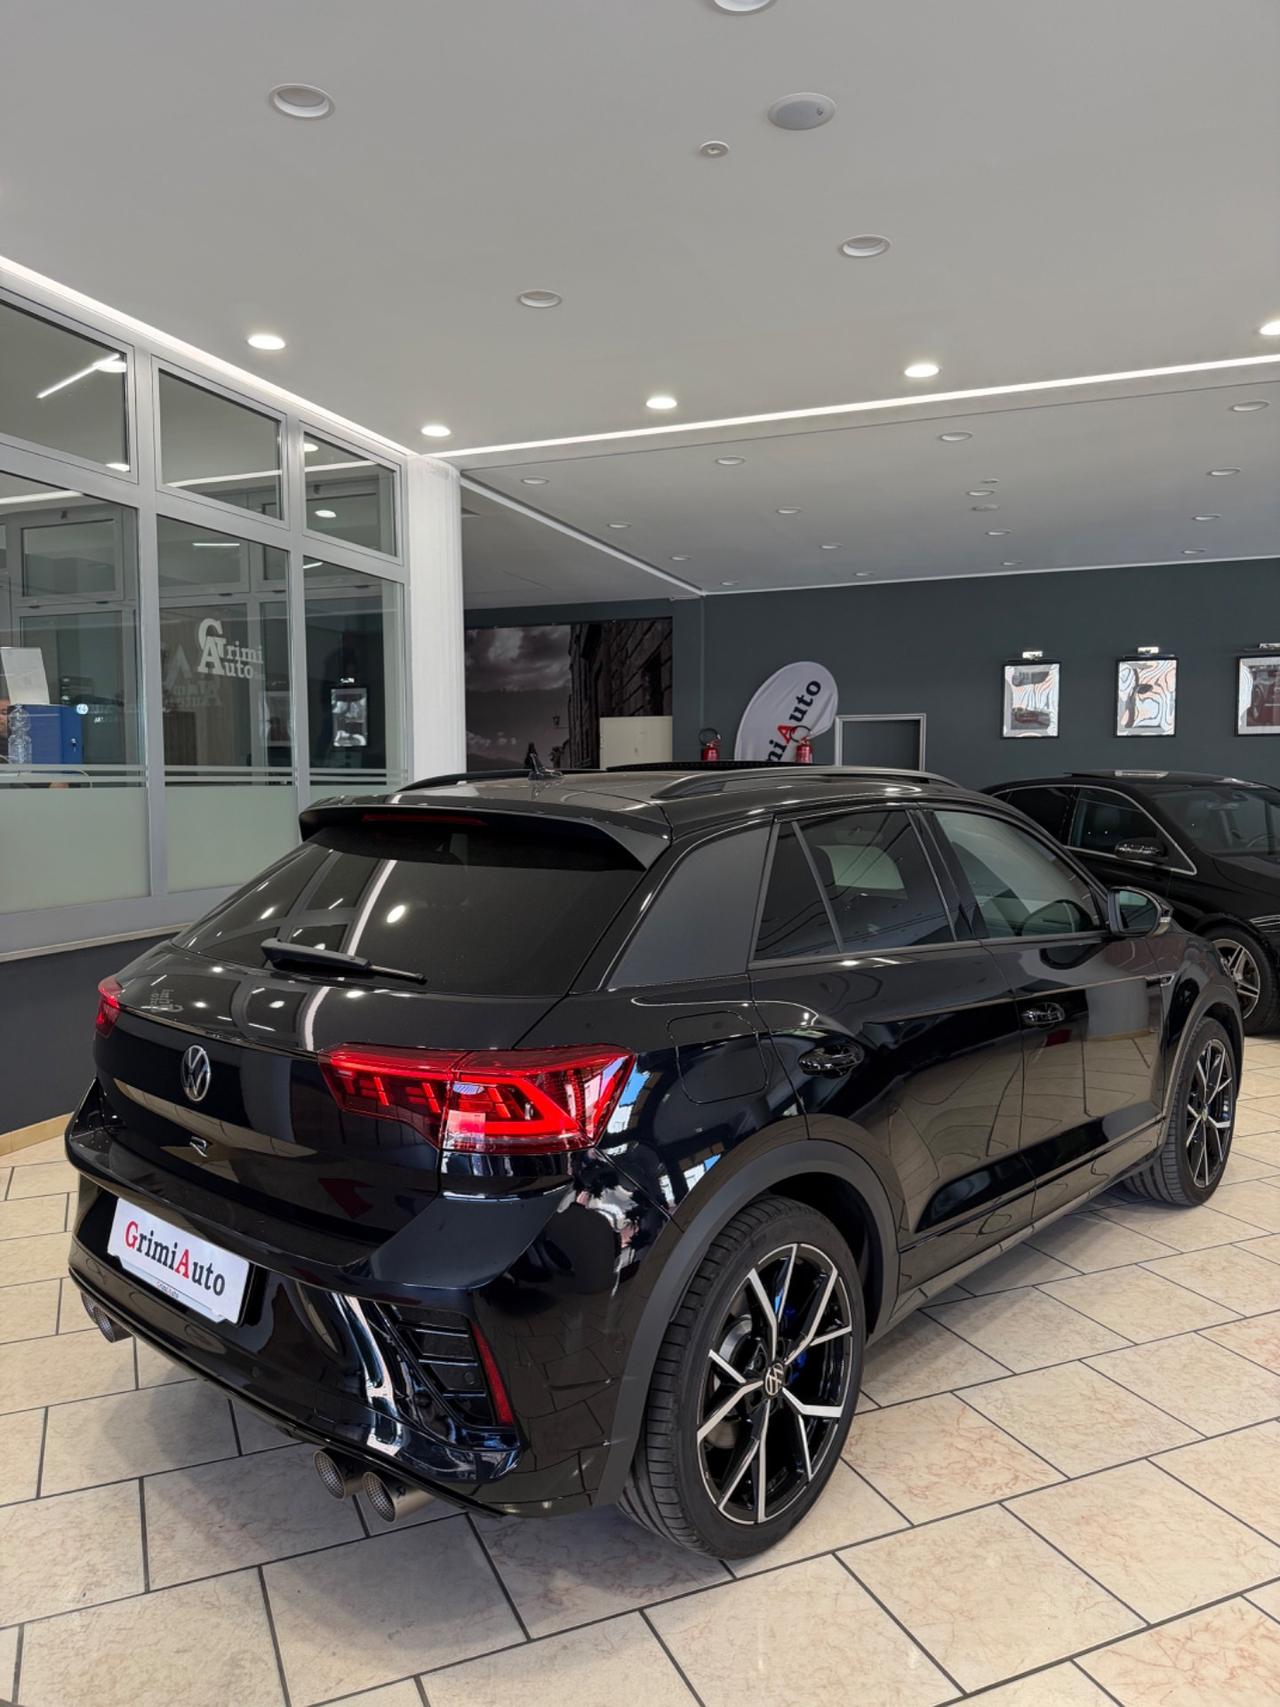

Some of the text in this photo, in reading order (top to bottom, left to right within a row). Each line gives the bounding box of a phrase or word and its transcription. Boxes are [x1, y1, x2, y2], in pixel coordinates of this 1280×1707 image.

[197, 636, 254, 679] Auto
[198, 618, 264, 664] Grimi
[125, 1220, 226, 1296] GrimiAuto
